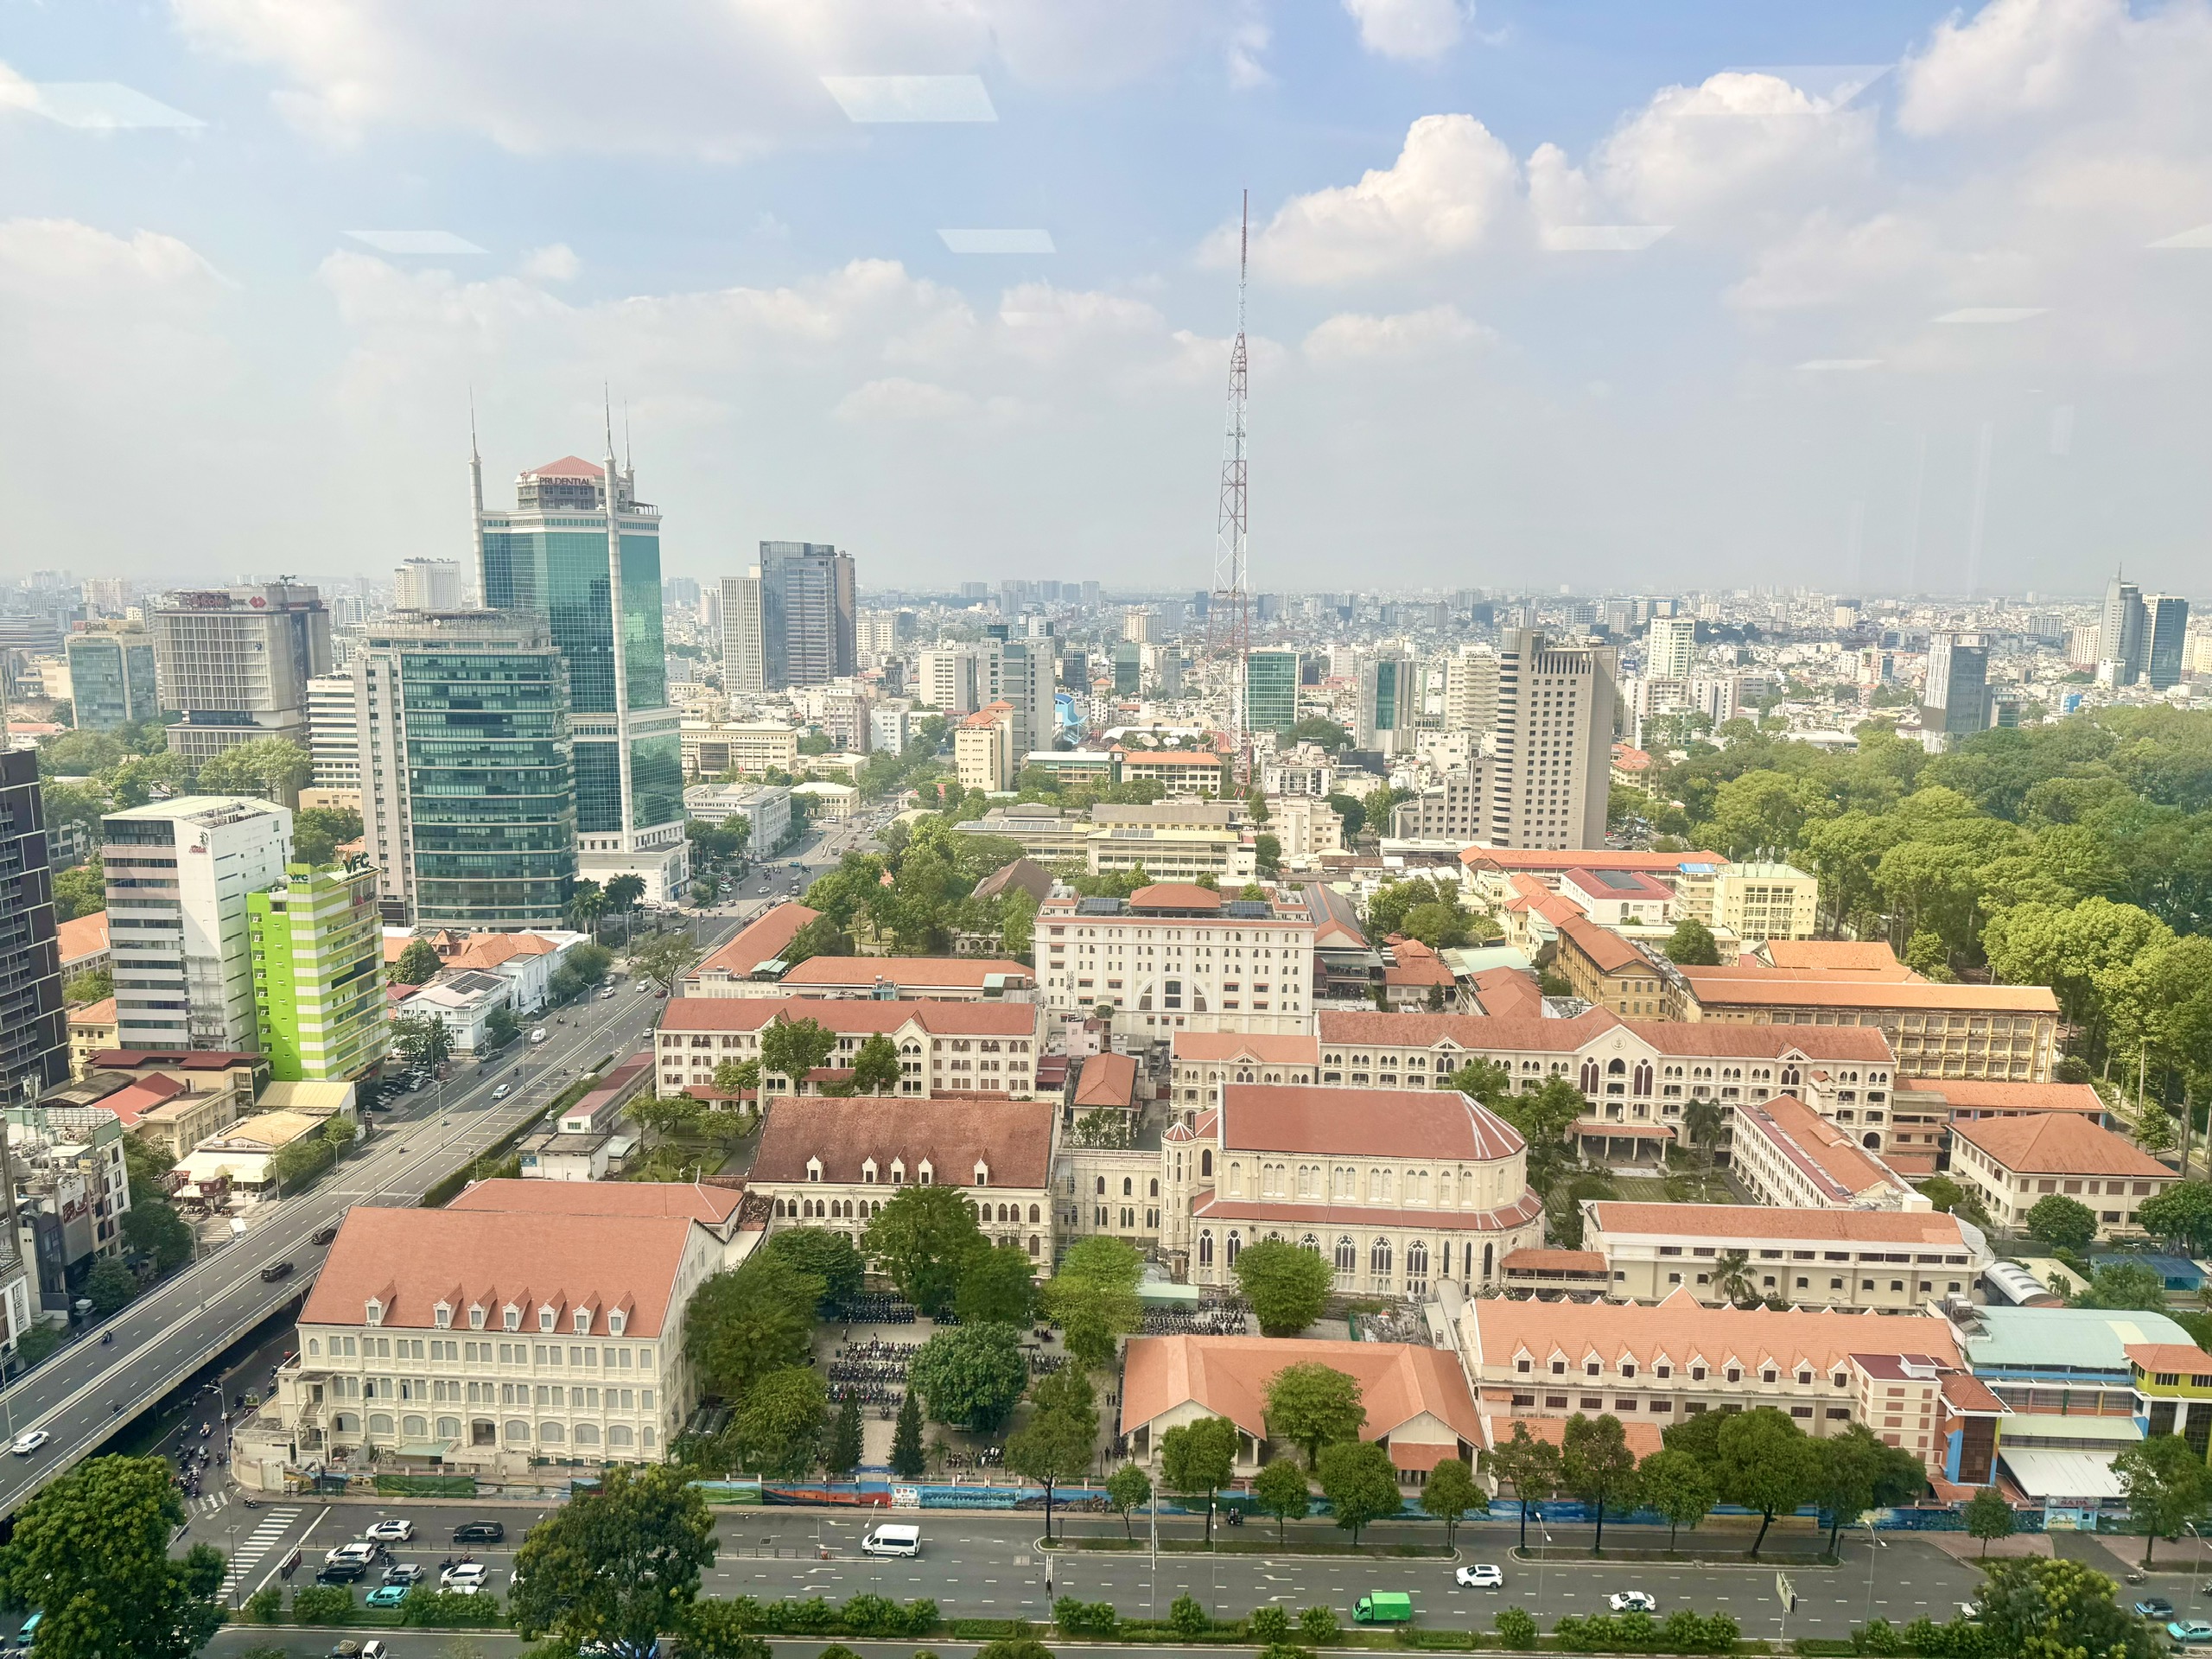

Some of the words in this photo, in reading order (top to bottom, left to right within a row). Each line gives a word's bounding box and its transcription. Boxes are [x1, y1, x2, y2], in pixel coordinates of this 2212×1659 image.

[539, 477, 591, 486] PRUDENTIAL
[187, 598, 246, 607] ECHCOMBANK
[73, 621, 109, 631] HDBank
[342, 851, 370, 874] VFC
